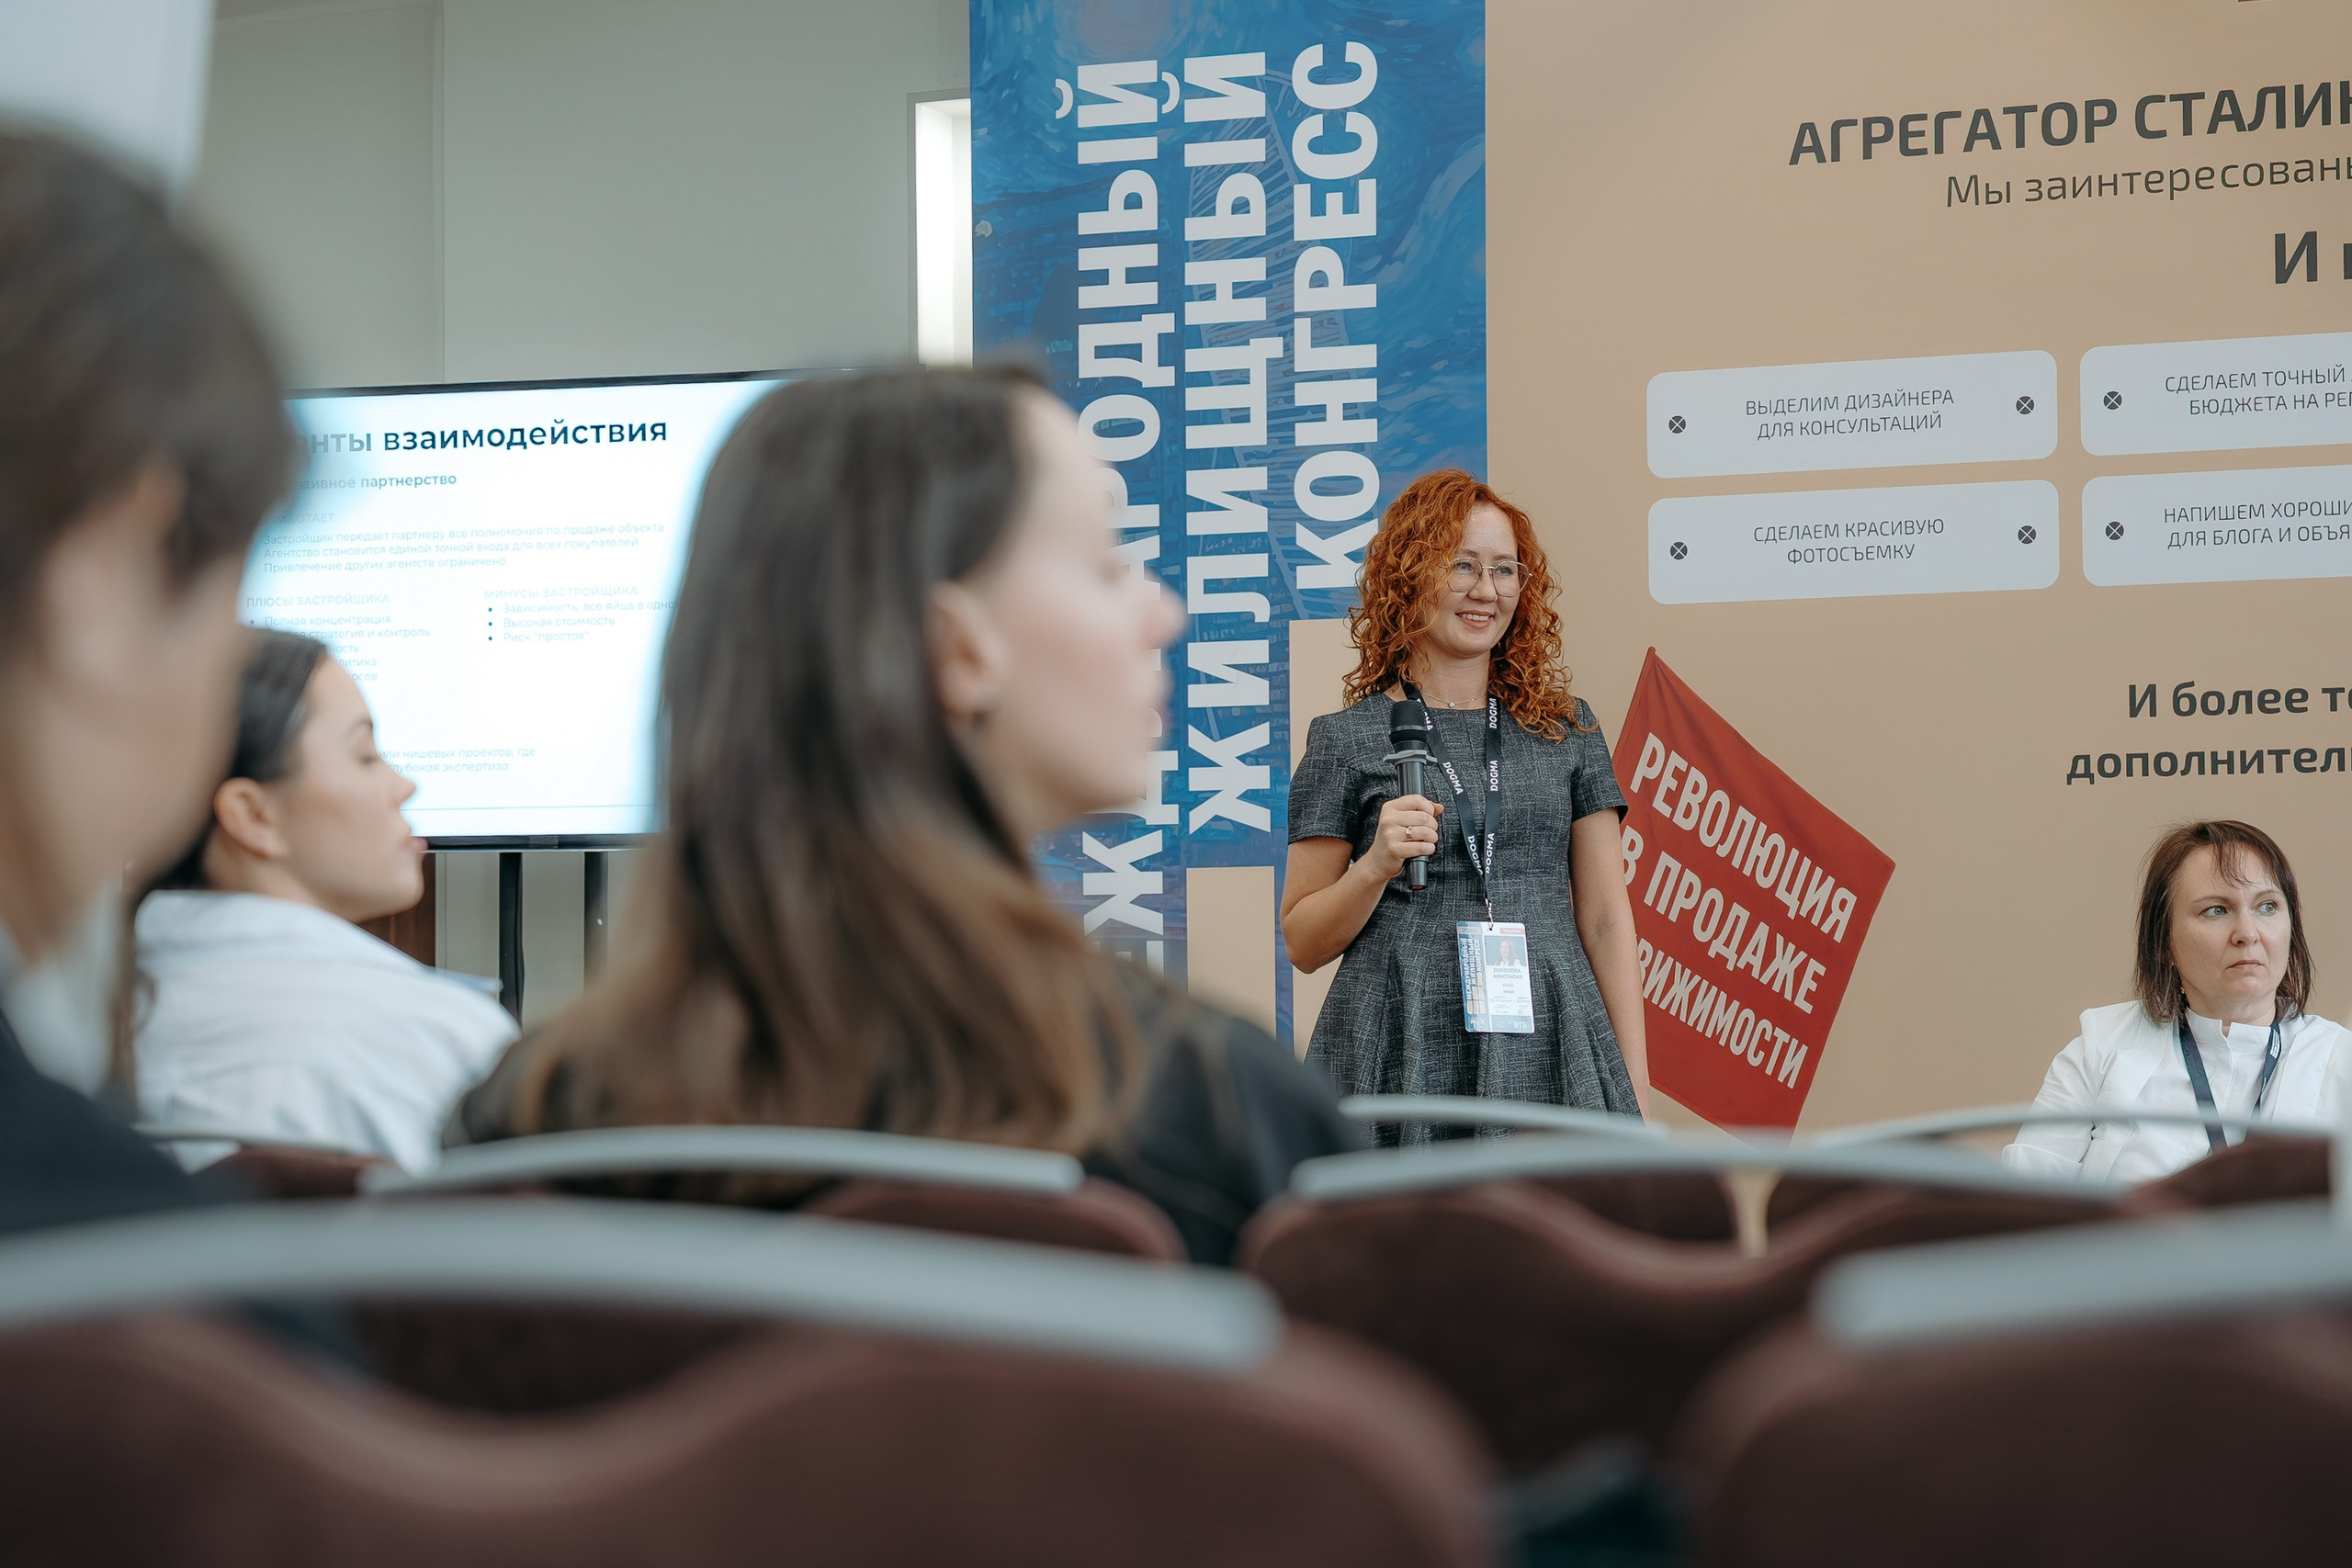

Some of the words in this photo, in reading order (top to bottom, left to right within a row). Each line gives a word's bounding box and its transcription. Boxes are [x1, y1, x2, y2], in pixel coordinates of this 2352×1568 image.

[1789, 98, 2118, 165] АГРЕГАТОР
[1947, 175, 2011, 208] Мы
[2274, 231, 2318, 285] И
[1292, 40, 1380, 590] КОНГРЕСС
[2165, 372, 2256, 394] СДЕЛАЕМ
[2262, 364, 2345, 387] ТОЧНЫЙ
[1746, 396, 1839, 417] ВЫДЕЛИМ
[1844, 389, 1955, 412] ДИЗАЙНЕРА
[2189, 395, 2288, 416] БЮДЖЕТА
[2293, 393, 2319, 410] НА
[383, 417, 668, 452] взаимодействия
[1757, 422, 1793, 441] ДЛЯ
[1800, 410, 1942, 436] КОНСУЛЬТАЦИЙ
[1161, 51, 1283, 832] ЖИЛИЩНЫЙ
[360, 475, 458, 490] партнерство
[2164, 503, 2265, 524] НАПИШЕМ
[264, 533, 333, 545] Застройщик
[336, 531, 389, 543] передает
[392, 530, 446, 541] партнеру
[447, 530, 468, 538] все
[470, 527, 543, 538] полномочия
[546, 526, 560, 536] по
[563, 525, 615, 536] продаже
[617, 523, 664, 533] объекта
[1753, 524, 1839, 544] СДЕЛАЕМ
[1845, 518, 1945, 538] КРАСИВУЮ
[2167, 530, 2207, 549] ДЛЯ
[2212, 527, 2273, 546] БЛОГА
[2278, 526, 2291, 543] И
[2297, 524, 2350, 542] ОБЪЯ
[264, 548, 320, 558] Агентство
[322, 545, 386, 556] становится
[388, 544, 431, 555] единой
[435, 542, 474, 553] точкой
[477, 542, 510, 552] входа
[512, 541, 533, 551] для
[536, 540, 561, 550] всех
[564, 537, 639, 551] покупателей
[1787, 543, 1916, 564] ФОТОСЪЕМКУ
[264, 562, 343, 574] Привлечение
[345, 559, 383, 570] других
[386, 558, 435, 569] агентств
[437, 556, 507, 569] ограничено
[246, 596, 293, 607] ПЛЮСЫ
[296, 592, 390, 606] ЗАСТРОЙЩИКА
[484, 589, 539, 600] МИНУСЫ
[542, 584, 639, 598] ЗАСТРОЙЩИКА
[583, 603, 603, 612] все
[605, 600, 634, 612] яйца
[265, 616, 306, 626] Полная
[310, 615, 392, 626] концентрация
[309, 629, 364, 640] стратегия
[378, 627, 432, 638] контроль
[503, 616, 552, 628] Высокая
[555, 616, 616, 626] стоимость
[503, 632, 531, 642] Риск
[1489, 697, 1498, 729] DOGMA
[2128, 683, 2157, 717] И
[2172, 681, 2309, 716] более
[2321, 687, 2352, 712] т
[379, 750, 401, 759] или
[402, 750, 456, 759] нишевых
[517, 747, 536, 758] где
[2066, 747, 2352, 785] дополнител
[1442, 761, 1464, 795] DOGMA
[1489, 760, 1498, 792] DOGMA
[1630, 732, 1858, 943] РЕВОЛЮЦИЯ
[1485, 832, 1495, 874] DOGMA
[1621, 825, 1644, 886] В
[1643, 851, 1826, 1014] ПРОДАЖЕ
[1638, 937, 1809, 1089] ВИЖИМОСТИ
